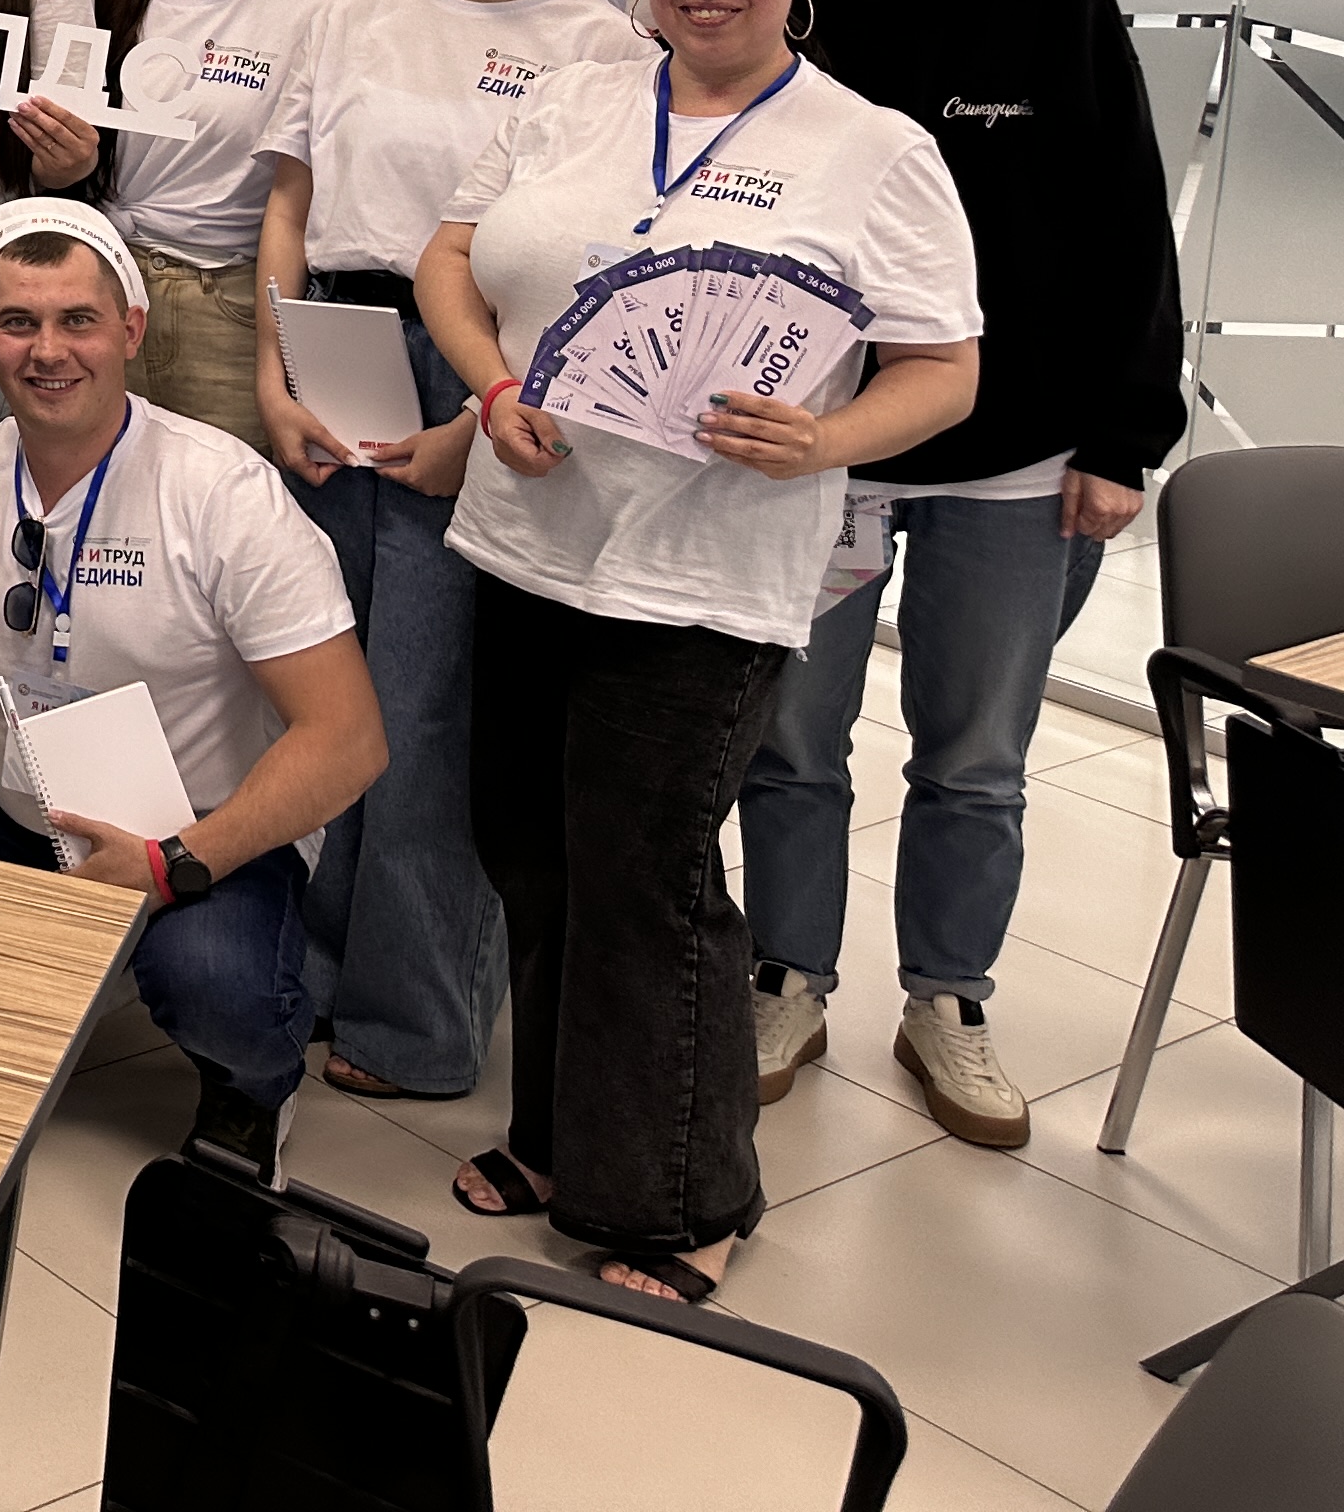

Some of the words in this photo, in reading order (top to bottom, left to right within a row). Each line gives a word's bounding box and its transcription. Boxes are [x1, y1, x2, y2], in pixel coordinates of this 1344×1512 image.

[203, 52, 215, 65] Я
[216, 54, 230, 67] И
[232, 54, 271, 76] ТРУД
[483, 60, 498, 74] Я
[497, 62, 513, 78] И
[515, 65, 540, 82] ТР
[200, 67, 267, 92] ЕДИНЫ
[695, 169, 712, 182] Я
[714, 171, 731, 184] И
[733, 173, 784, 197] ТРУД
[690, 183, 777, 211] ЕДИНЫ
[639, 262, 655, 275] 36
[654, 255, 677, 271] 000
[805, 272, 821, 287] 36
[818, 280, 840, 299] 000
[567, 310, 584, 326] 36
[578, 295, 599, 316] 000
[779, 321, 809, 351] 36
[752, 353, 792, 398] 000
[88, 549, 101, 563] И
[102, 549, 146, 567] ТРУД
[74, 567, 144, 587] ЕДИНЫ
